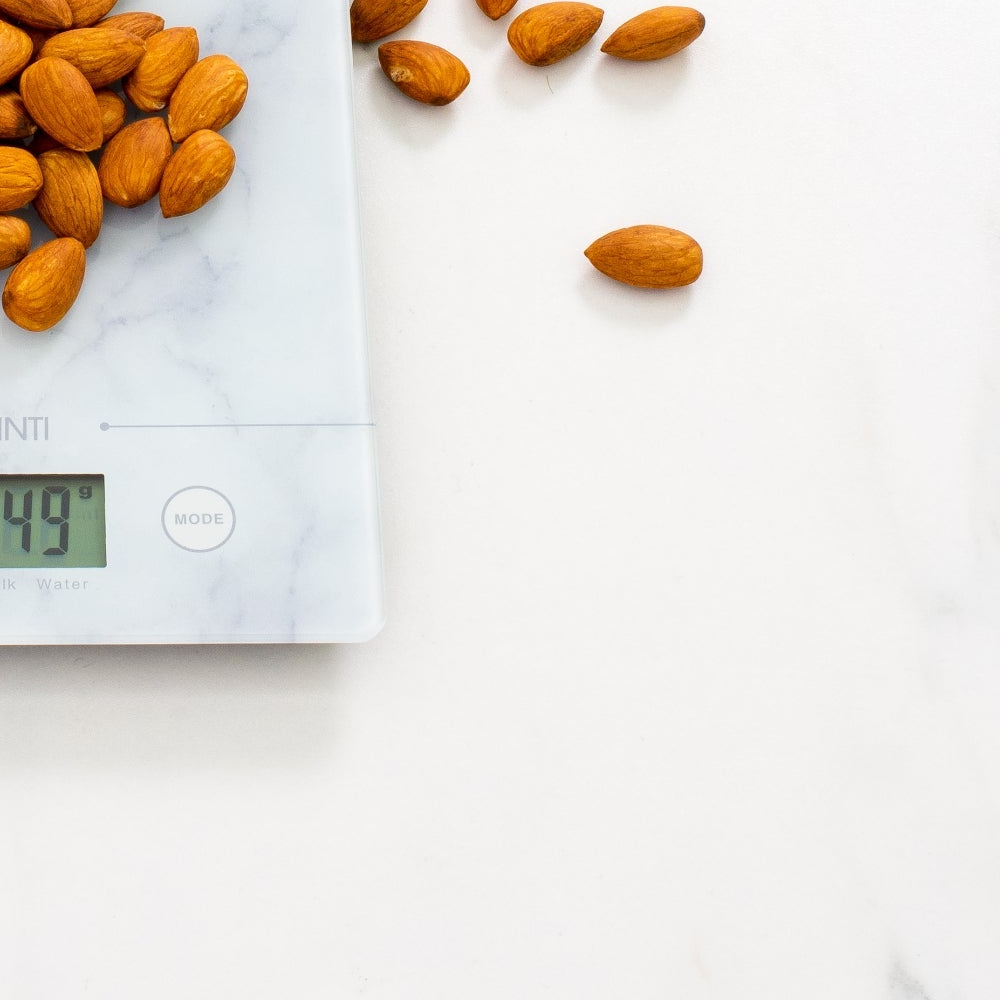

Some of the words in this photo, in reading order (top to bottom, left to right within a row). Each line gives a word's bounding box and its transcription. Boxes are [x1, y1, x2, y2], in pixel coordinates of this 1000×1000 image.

[3, 485, 71, 556] 49
[174, 512, 225, 526] MODE
[37, 577, 89, 591] Water
